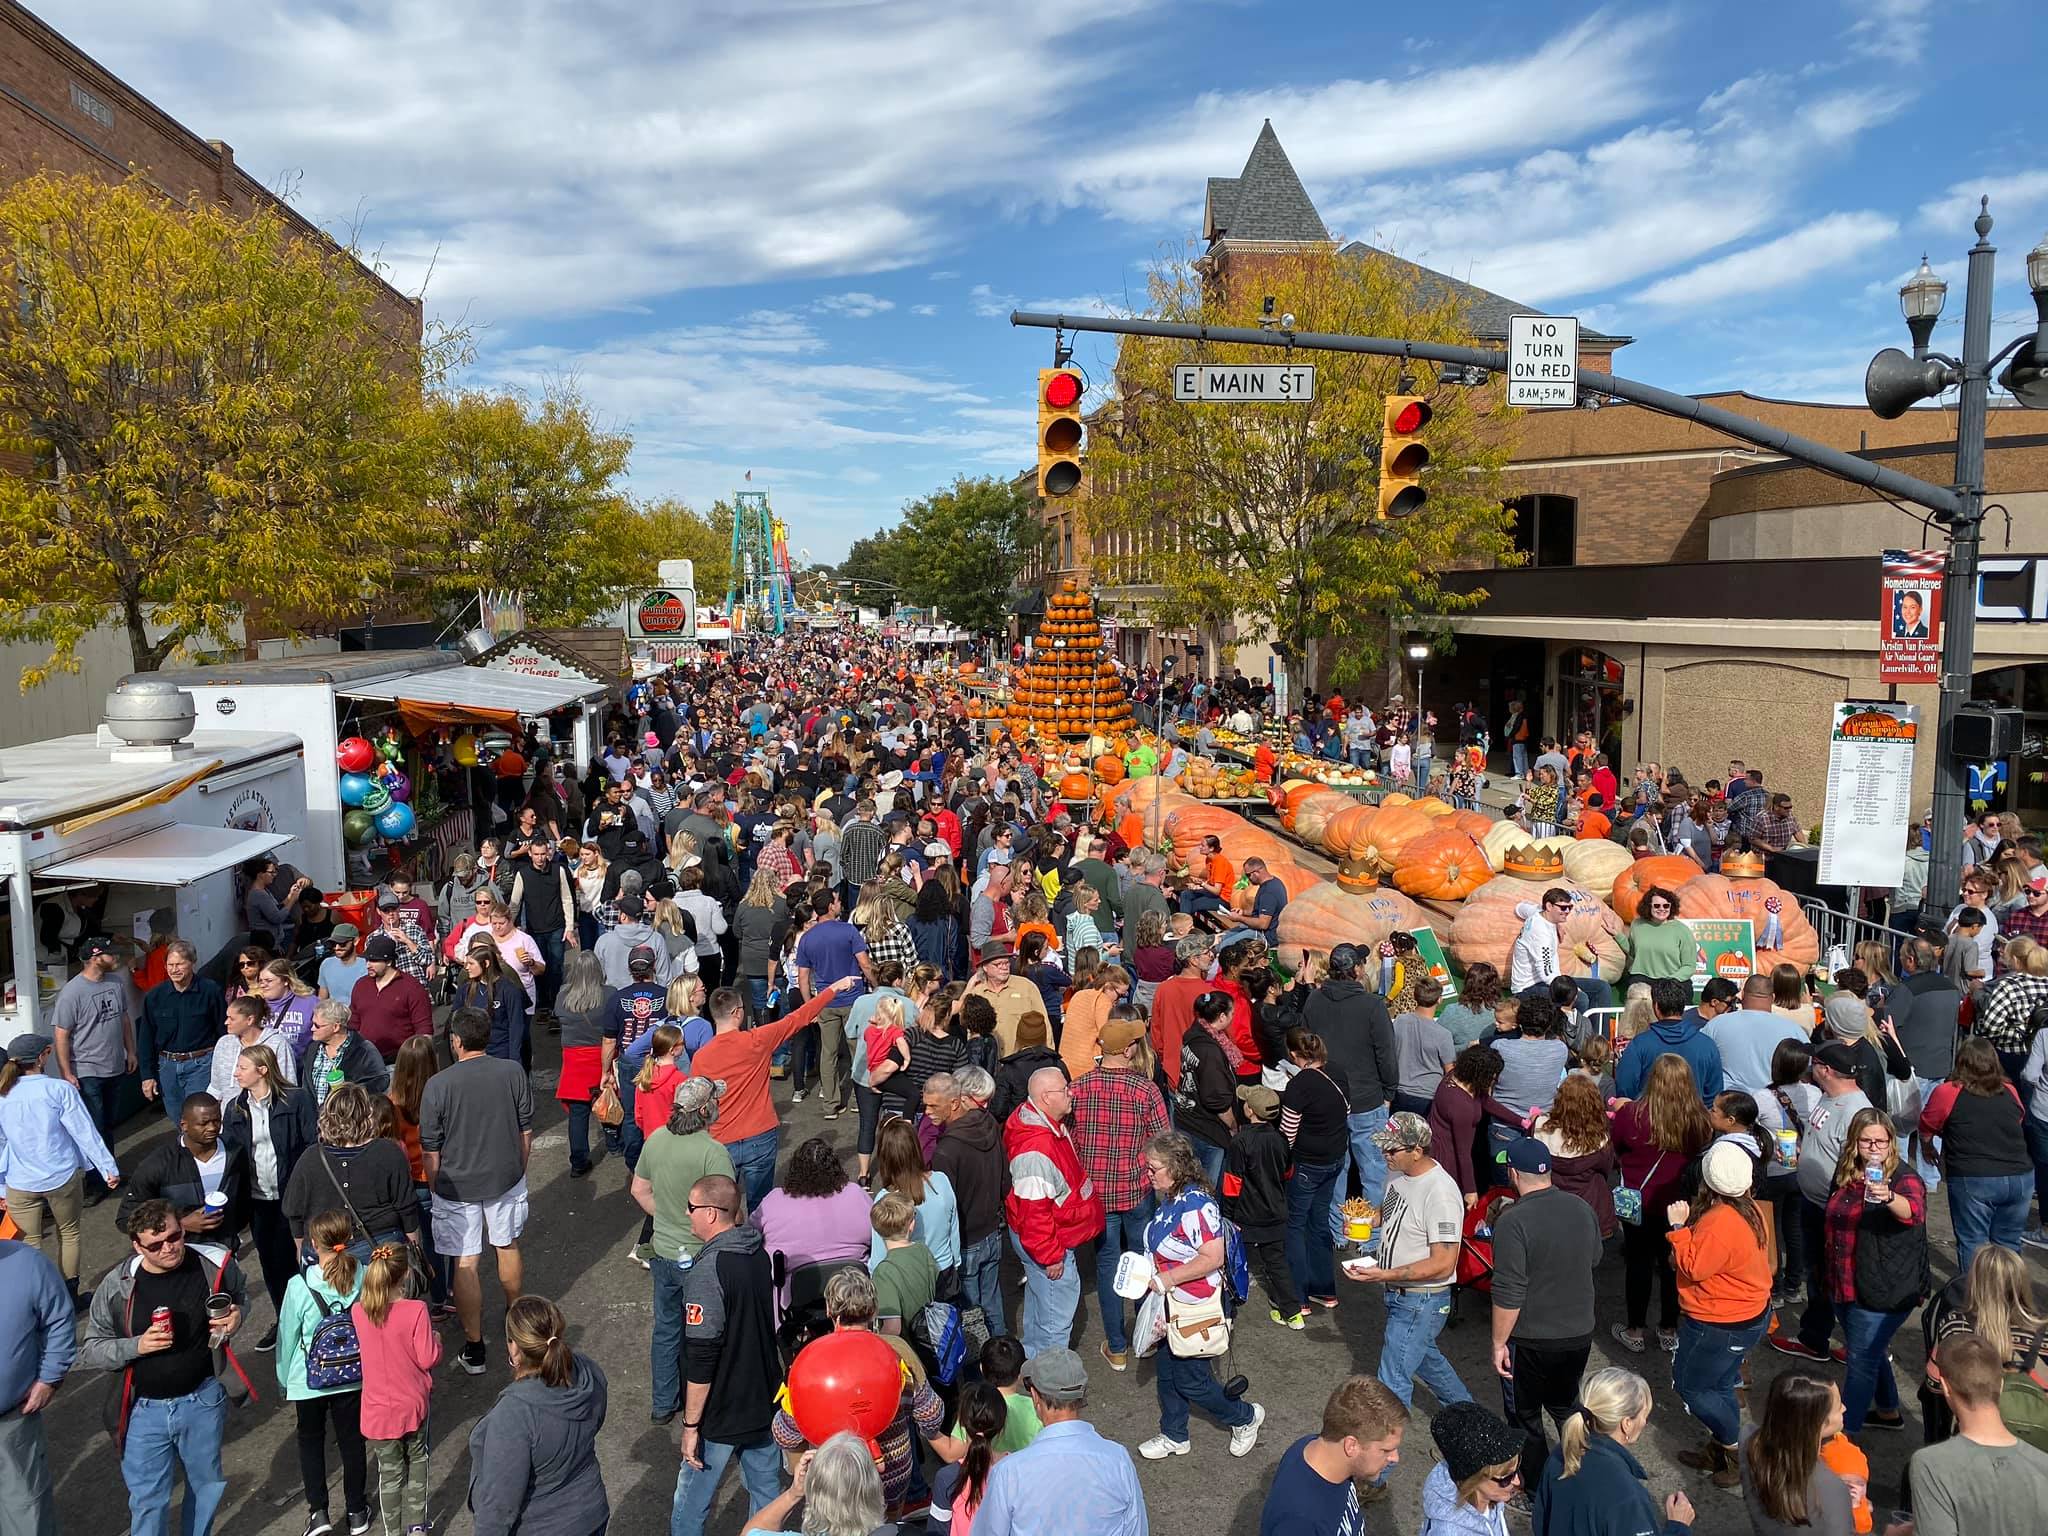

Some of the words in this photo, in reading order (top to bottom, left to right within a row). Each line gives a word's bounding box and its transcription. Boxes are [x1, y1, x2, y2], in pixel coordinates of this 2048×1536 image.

[1532, 324, 1556, 337] NO
[1524, 343, 1563, 358] TURN
[1515, 363, 1535, 377] ON
[1541, 363, 1571, 378] RED
[1183, 373, 1196, 393] E
[1210, 373, 1264, 393] MAIN
[1279, 373, 1305, 394] ST
[1884, 577, 1919, 589] Hometown
[1919, 578, 1942, 589] Heroes
[1905, 640, 1917, 651] Van
[507, 654, 540, 666] Swiss
[1884, 653, 1893, 661] Air
[1894, 653, 1917, 661] National
[1918, 653, 1935, 661] Guard
[1924, 664, 1937, 673] OH
[1116, 1255, 1130, 1290] GEICO
